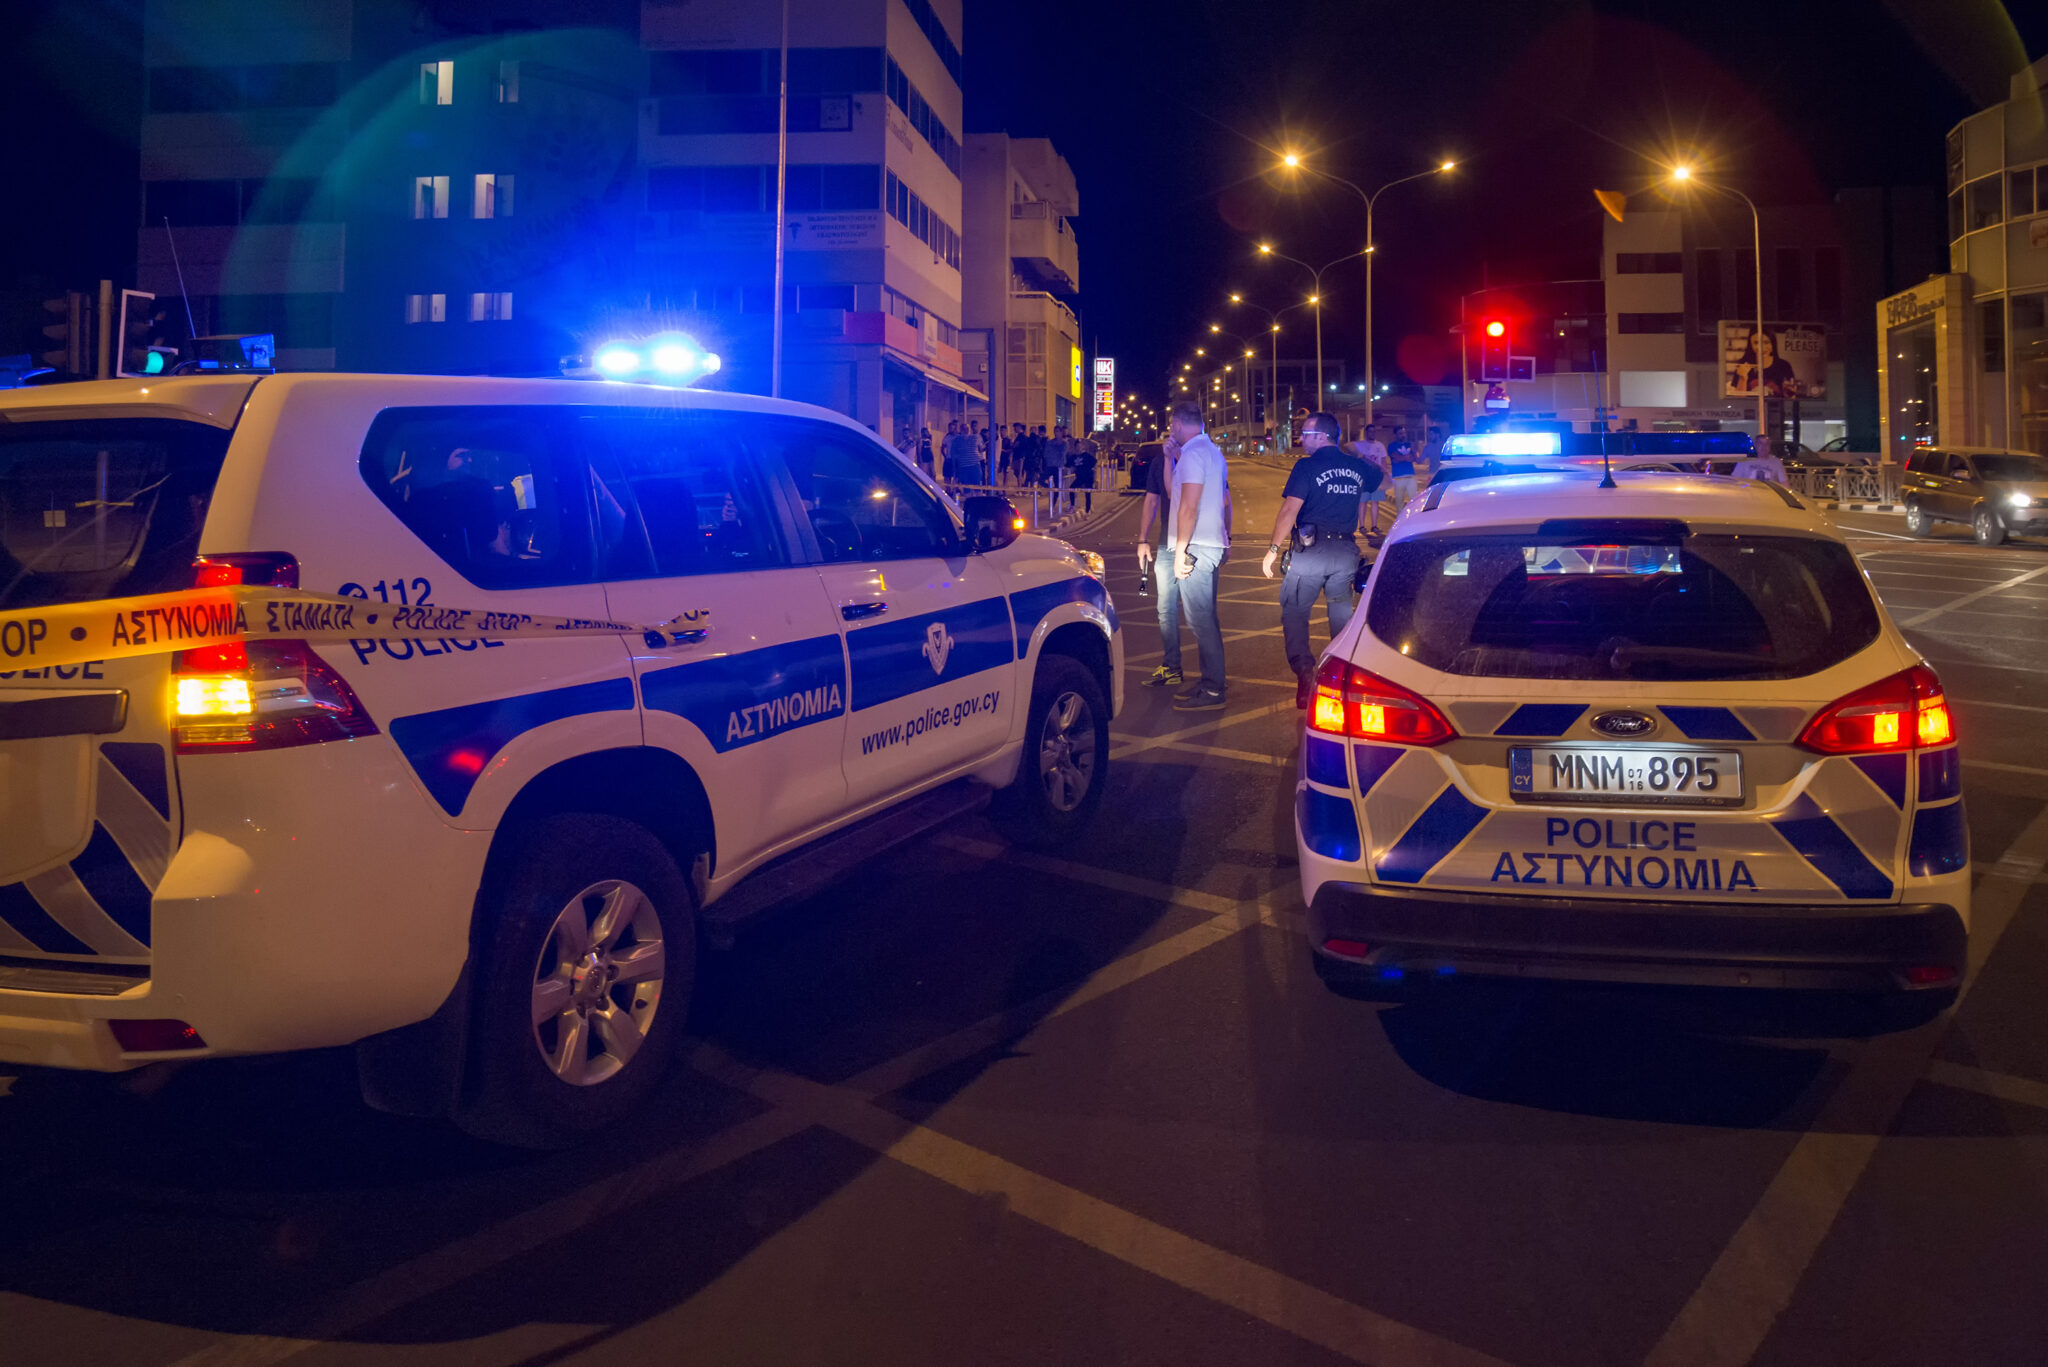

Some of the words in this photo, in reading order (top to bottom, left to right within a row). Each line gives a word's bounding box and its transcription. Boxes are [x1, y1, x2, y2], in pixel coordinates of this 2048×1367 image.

[1327, 484, 1358, 495] POLICE
[373, 577, 435, 607] 112
[112, 603, 249, 647] ΑΣΤΥΝΟΜΙΑ
[267, 602, 355, 632] ΣΤΑΜΑΤΑ
[393, 607, 471, 630] POLICE
[726, 684, 842, 743] ΑΣΤΥΝΟΜΙΑ
[862, 690, 1000, 755] www.police.gov.cy
[1514, 775, 1531, 786] CY
[1550, 753, 1625, 790] MNM
[1648, 756, 1720, 791] 895
[1628, 768, 1643, 779] 07
[1629, 780, 1644, 791] 16
[1546, 817, 1697, 852] POLICE
[1490, 851, 1760, 893] ΑΣΤΥΝΟΜΙΑ
